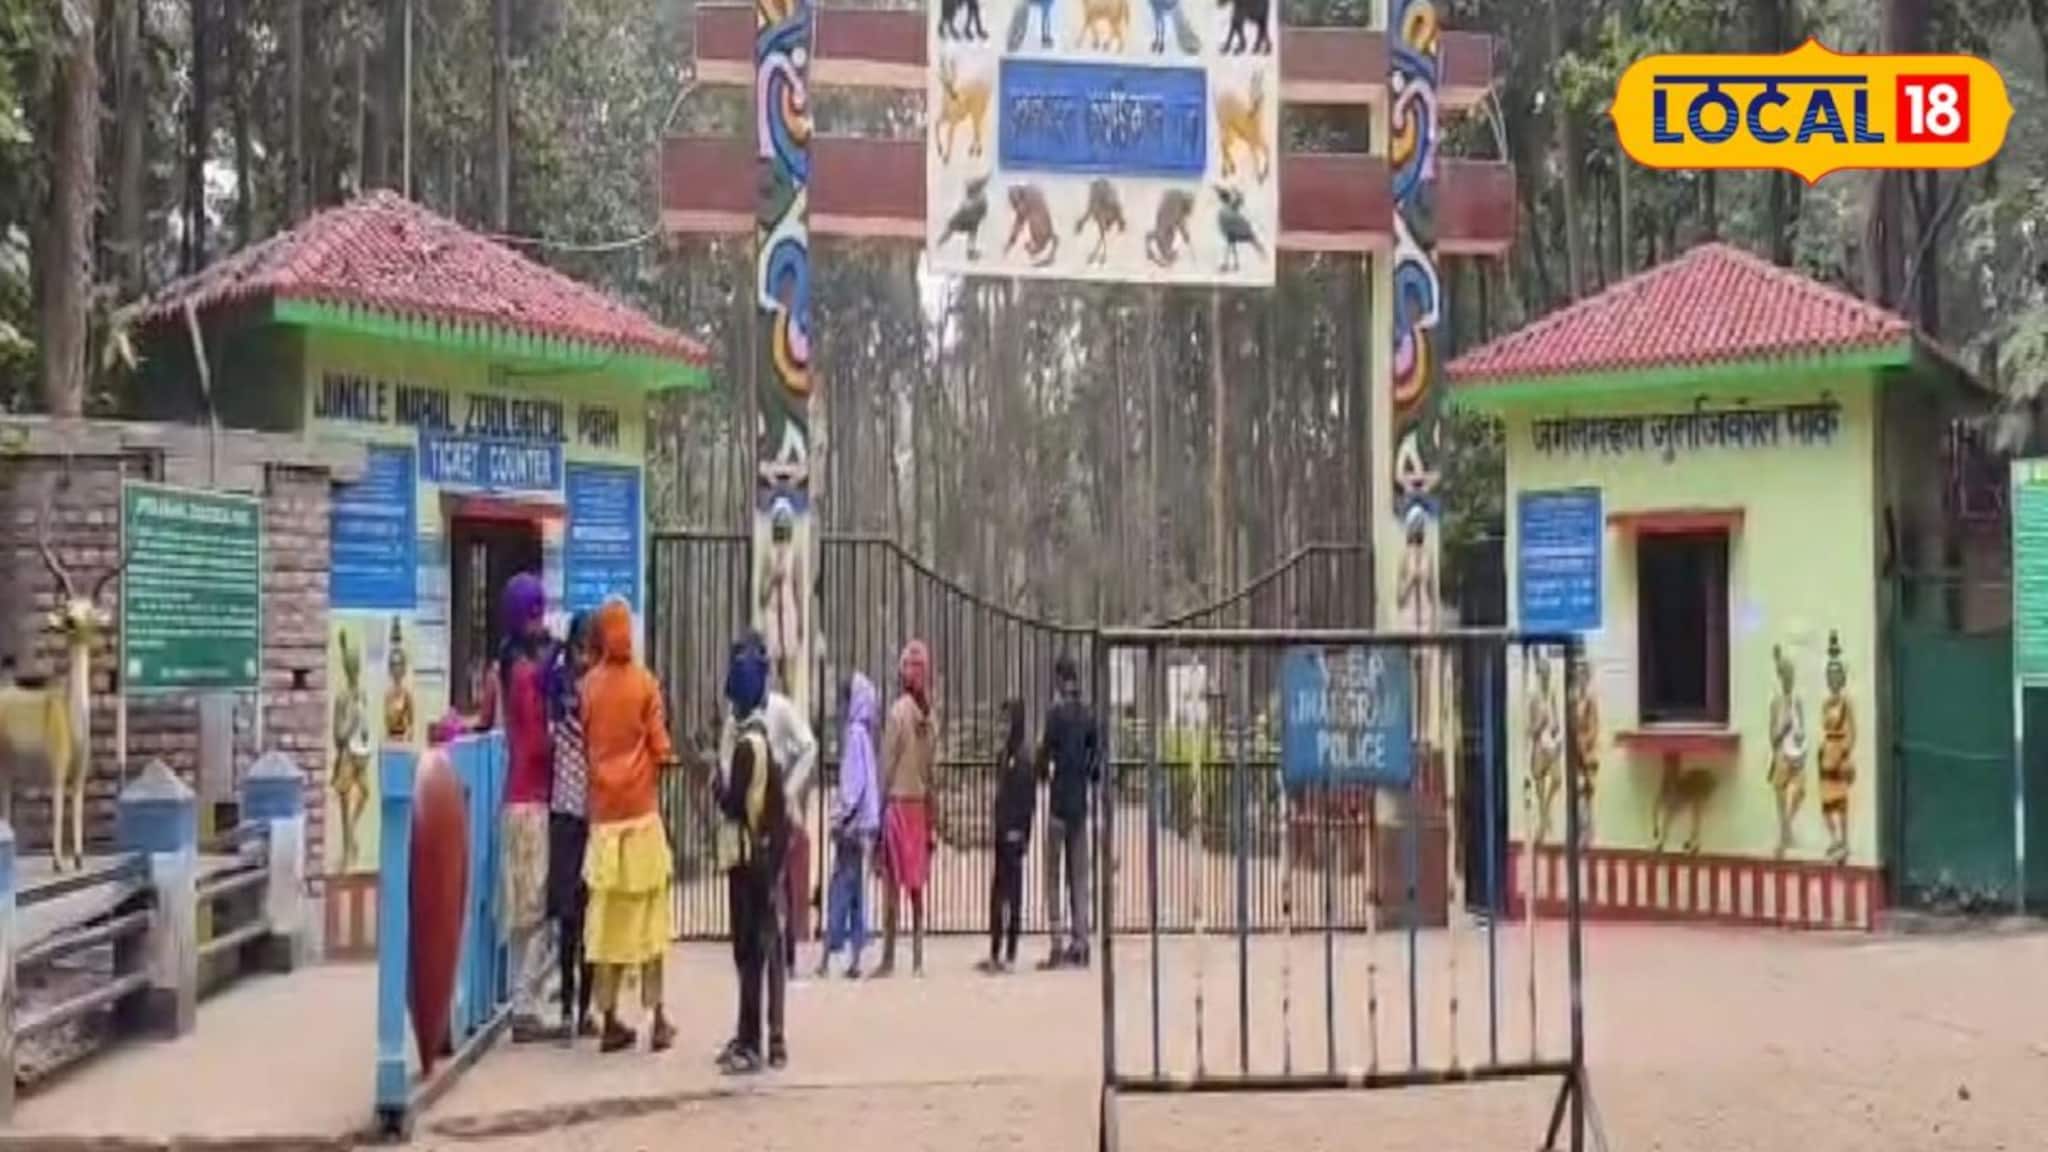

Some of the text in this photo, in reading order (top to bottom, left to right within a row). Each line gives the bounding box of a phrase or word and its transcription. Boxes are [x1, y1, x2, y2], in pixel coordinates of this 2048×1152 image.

[430, 441, 552, 482] TICKET COUNTER
[1317, 728, 1386, 769] POLICE
